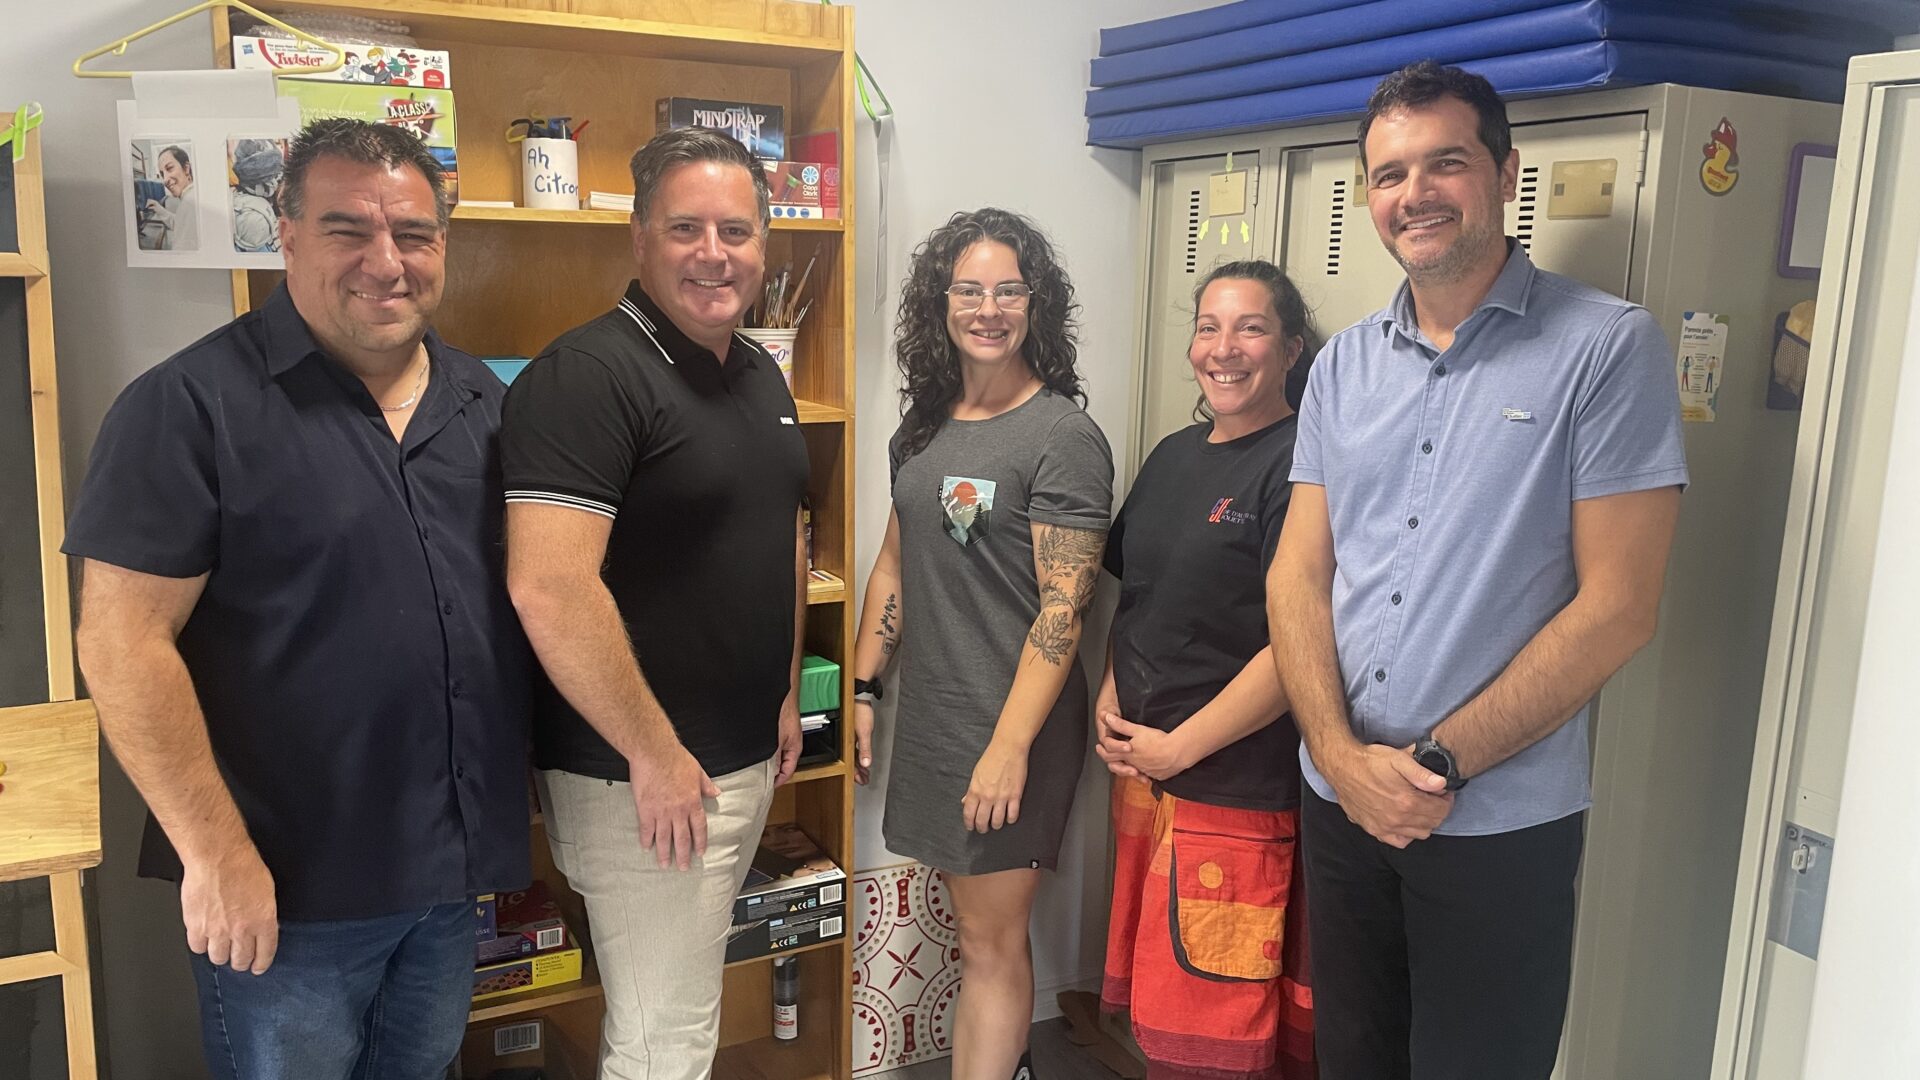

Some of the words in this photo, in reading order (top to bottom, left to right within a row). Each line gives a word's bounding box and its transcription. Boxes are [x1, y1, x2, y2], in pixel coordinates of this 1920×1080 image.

[275, 52, 324, 67] Twister
[692, 105, 767, 138] MINDTRAP
[527, 146, 549, 170] Ah
